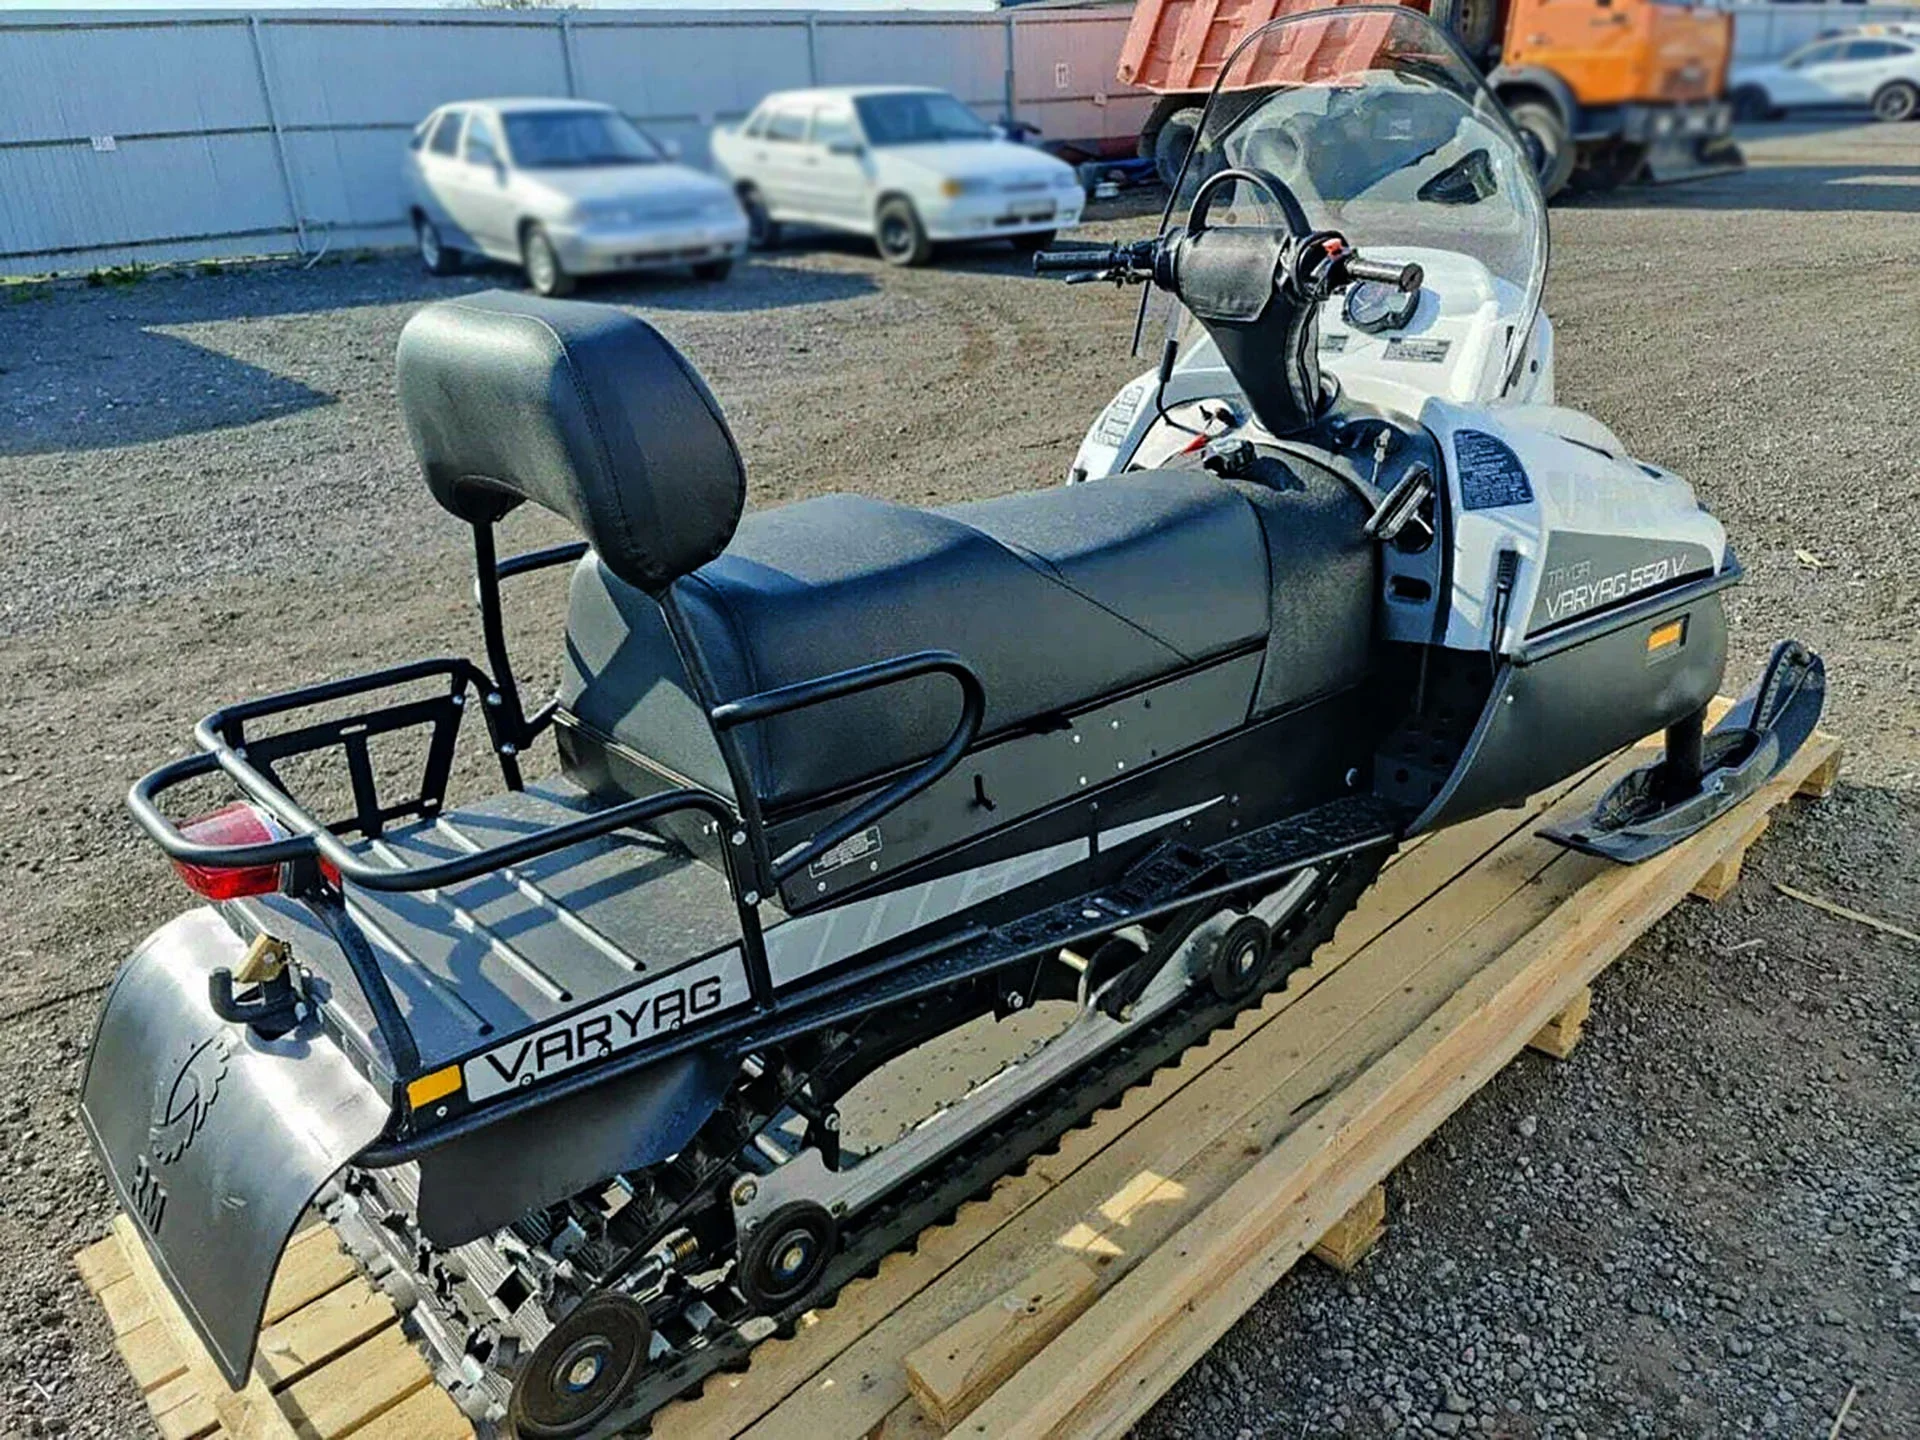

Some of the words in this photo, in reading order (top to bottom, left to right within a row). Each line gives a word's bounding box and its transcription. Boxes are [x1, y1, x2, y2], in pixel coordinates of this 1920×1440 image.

[1545, 573, 1628, 621] VARYAG
[1630, 559, 1669, 594] 550
[1672, 554, 1688, 578] V
[485, 975, 722, 1083] VARYAG
